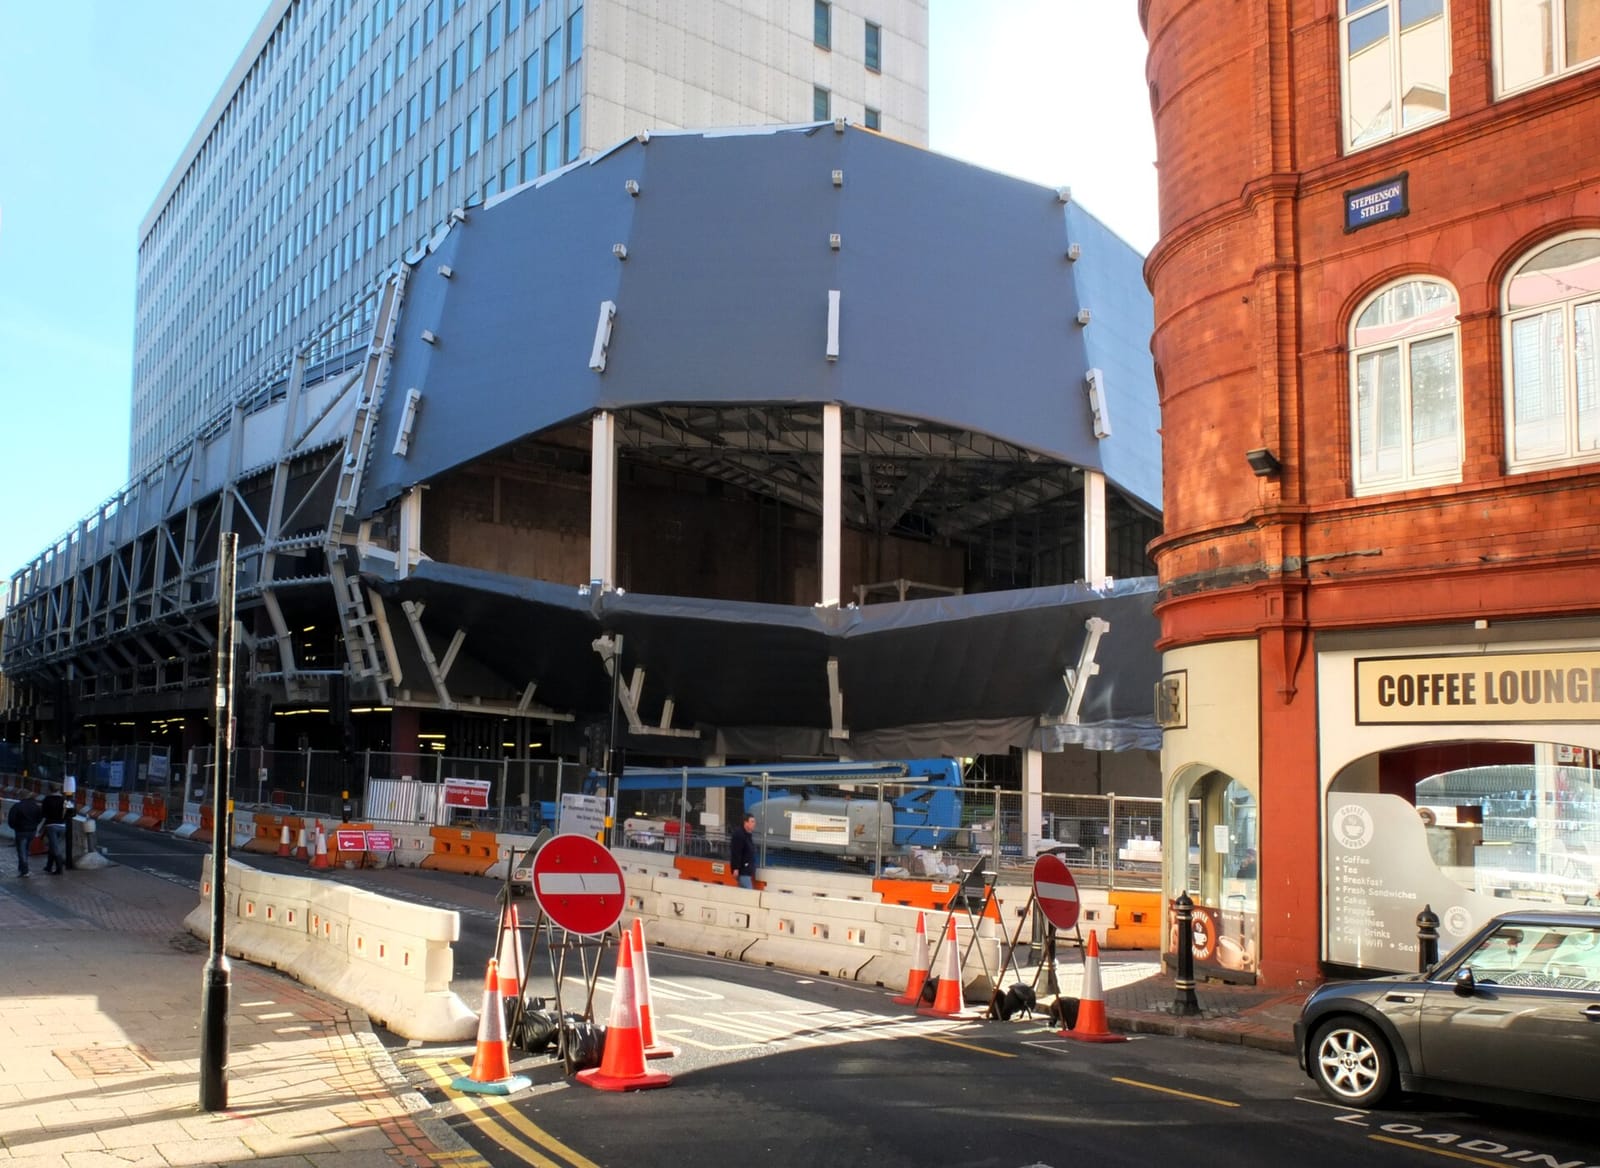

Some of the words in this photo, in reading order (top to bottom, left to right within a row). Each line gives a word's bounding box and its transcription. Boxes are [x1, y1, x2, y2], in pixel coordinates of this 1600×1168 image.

[1350, 185, 1400, 211] STEPHENSON
[1360, 200, 1390, 219] STREET
[1377, 673, 1477, 707] COFFEE
[1484, 667, 1600, 705] LOUNGE
[1343, 856, 1370, 865] Coffee
[1343, 865, 1358, 874] Tea
[1343, 875, 1383, 886] Breakfast
[1343, 886, 1365, 895] Fresh
[1368, 888, 1416, 900] Sandwiches
[1364, 928, 1391, 939] Drinks
